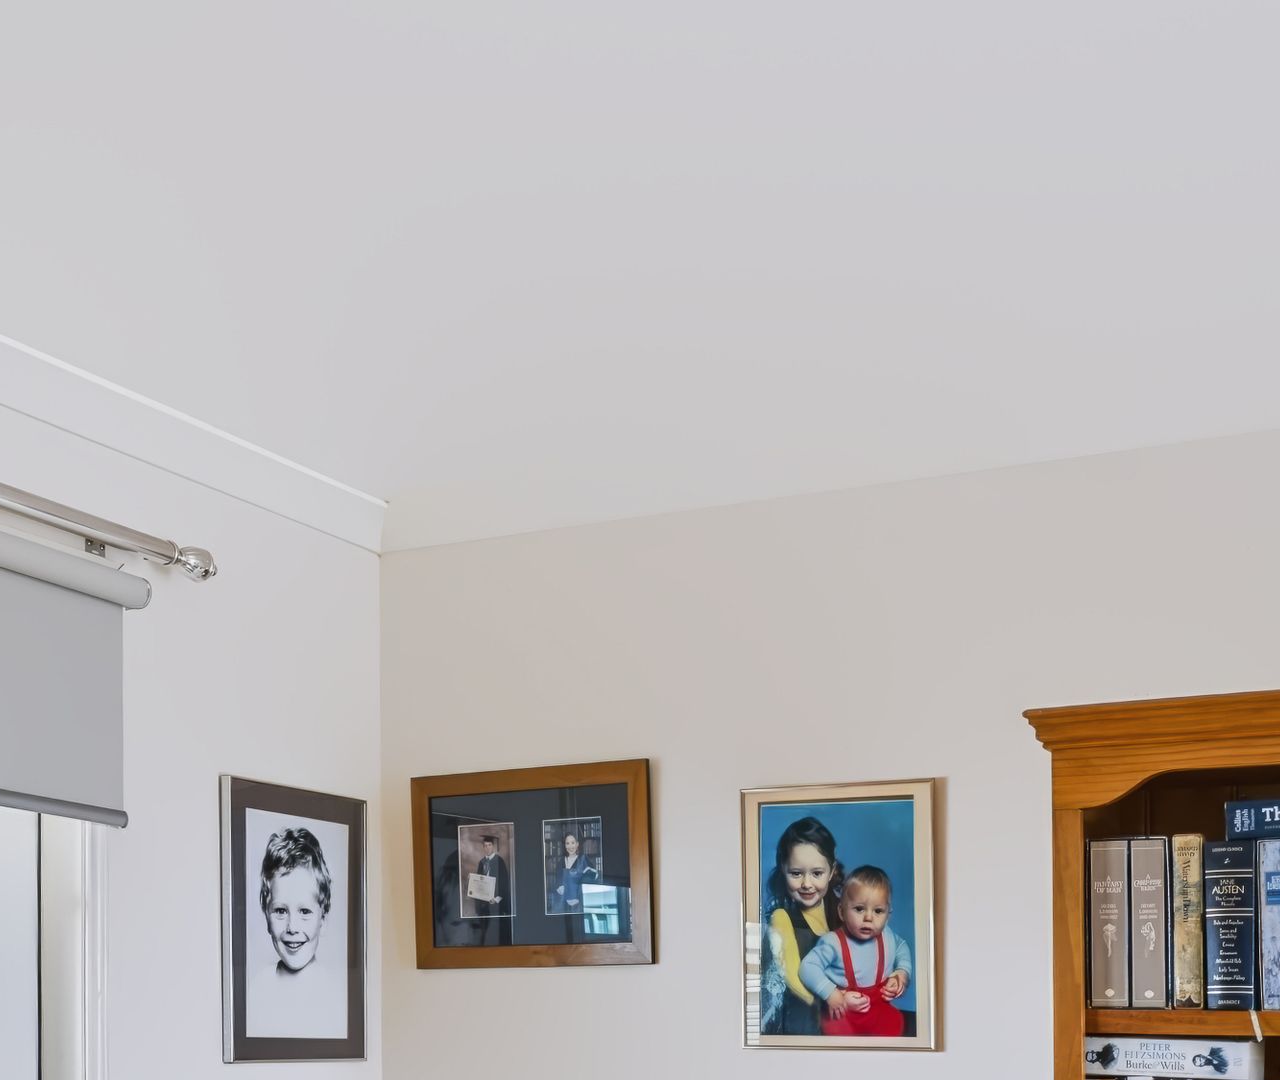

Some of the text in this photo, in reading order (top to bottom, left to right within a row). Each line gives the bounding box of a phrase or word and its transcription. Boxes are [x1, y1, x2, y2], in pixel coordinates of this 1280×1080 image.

[1212, 886, 1245, 894] AUSTEN
[1140, 1043, 1170, 1051] PETER
[1125, 1052, 1186, 1060] FITZSIMONS
[1126, 1061, 1185, 1071] Burke Wills
